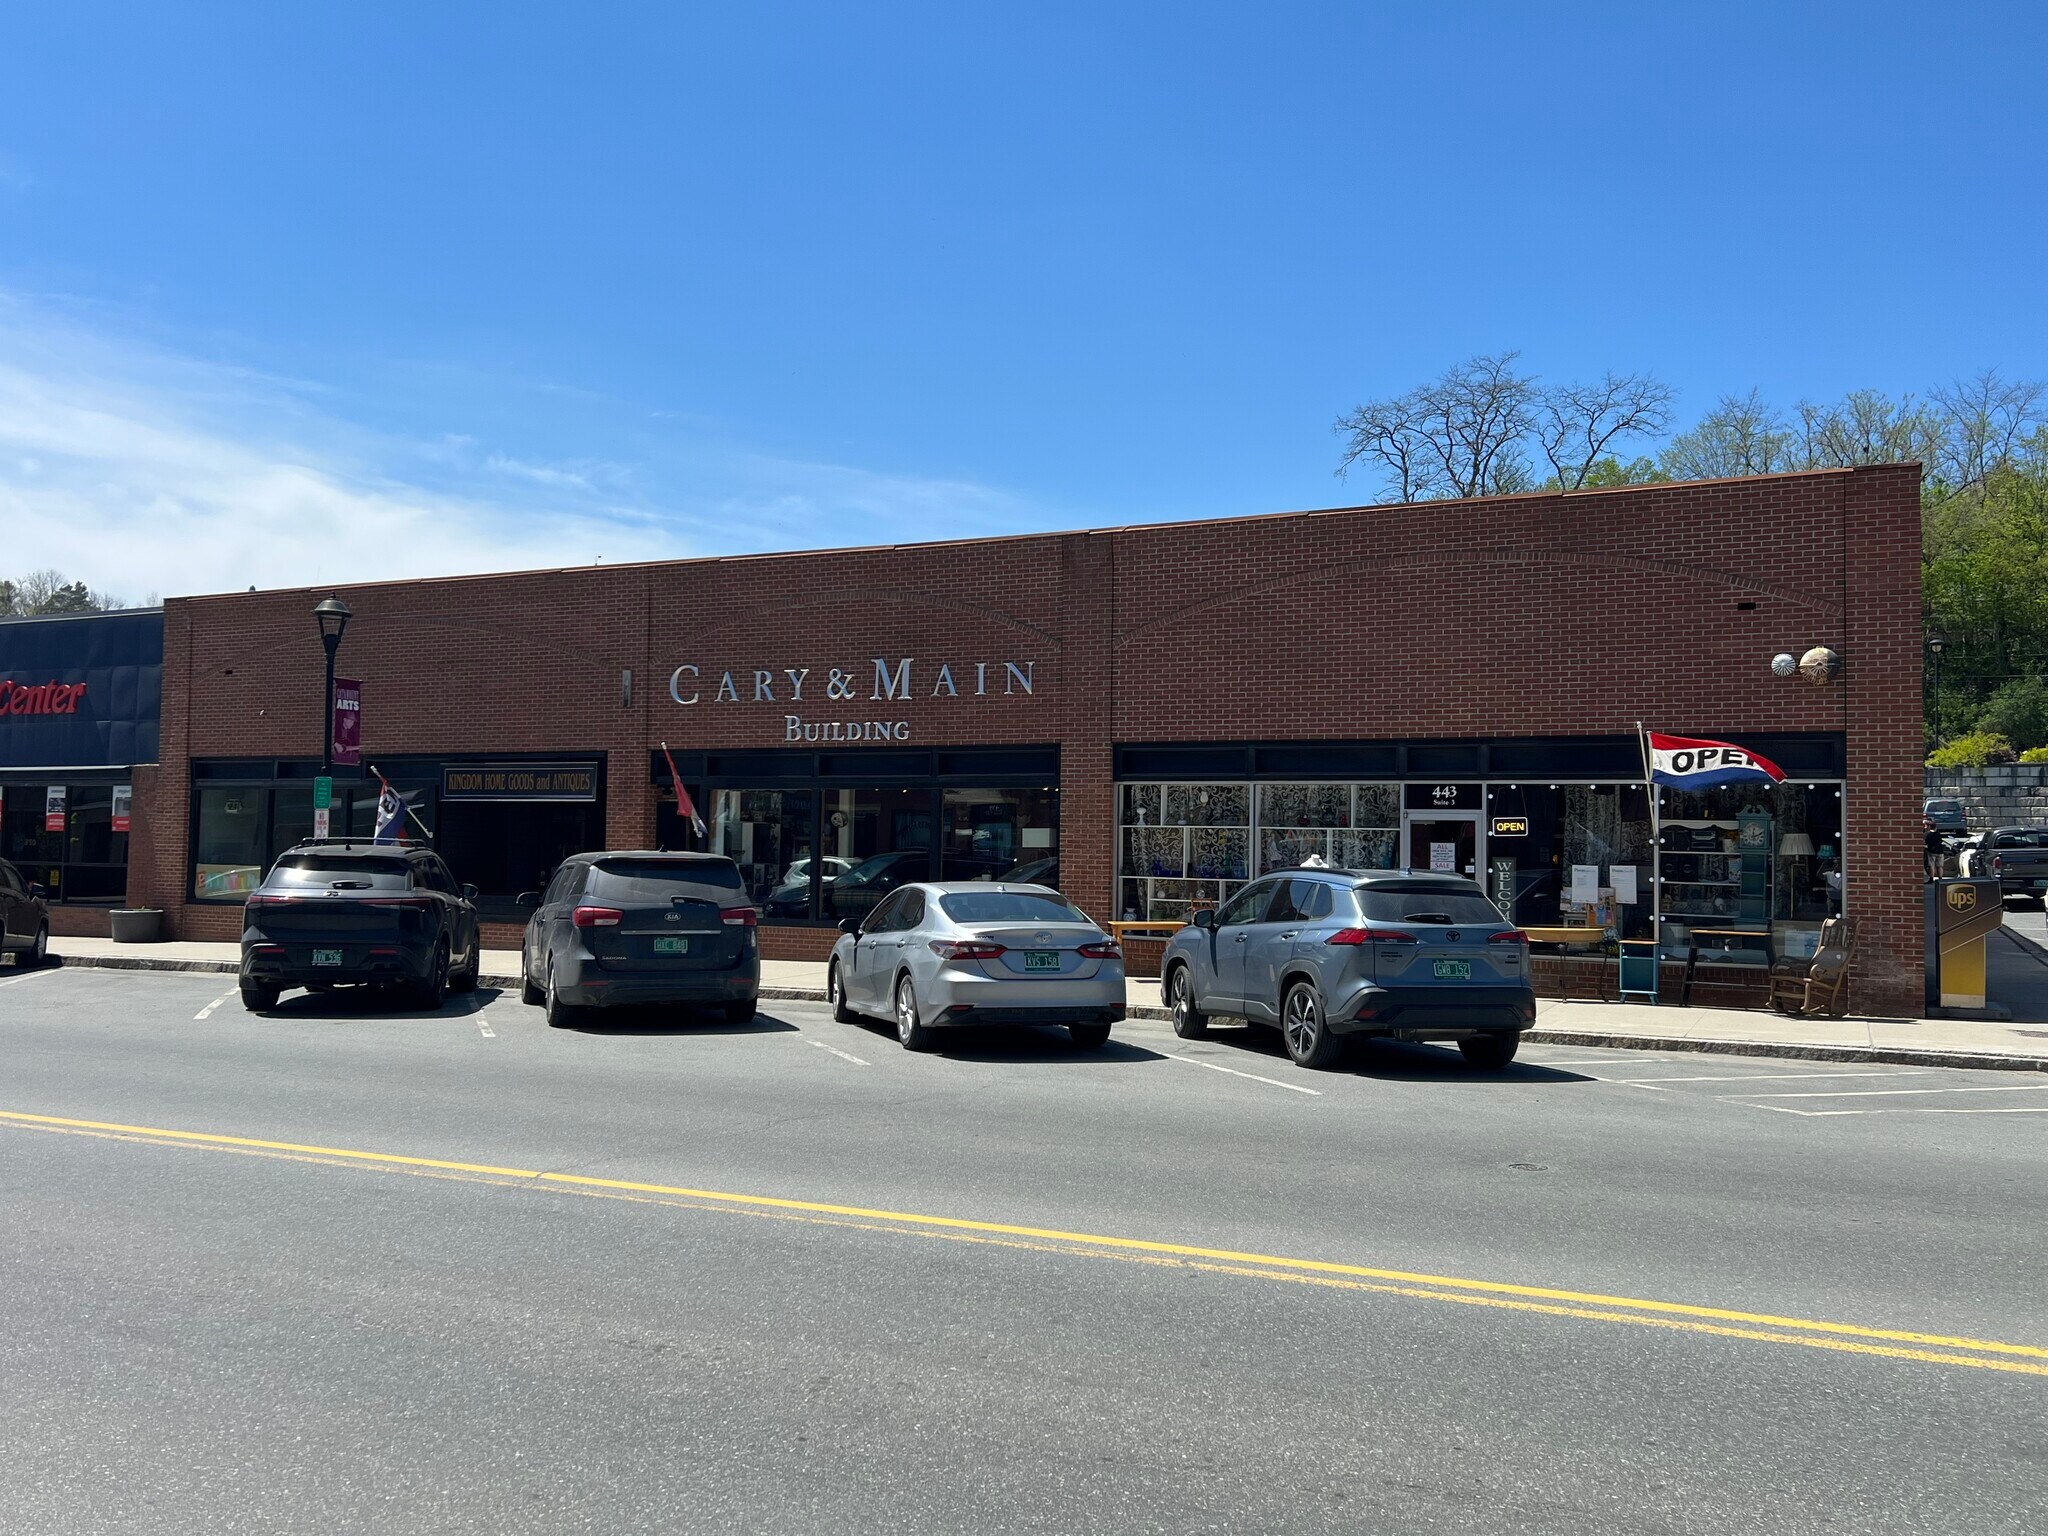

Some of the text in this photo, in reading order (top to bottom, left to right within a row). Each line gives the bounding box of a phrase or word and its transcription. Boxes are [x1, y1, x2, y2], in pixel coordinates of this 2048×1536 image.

[669, 657, 1036, 705] CARY & MAIN
[0, 679, 87, 716] Center
[336, 699, 360, 711] ARTS
[784, 715, 910, 741] BUILDING
[1671, 748, 1755, 773] OPE
[448, 773, 590, 791] KINGDOM HOME GOODS and ANTIQUES
[1432, 785, 1458, 799] 443
[1496, 822, 1525, 832] OPEN
[1496, 861, 1512, 921] WELCOM
[1949, 891, 1975, 909] ups
[1027, 956, 1058, 966] KVS 158
[1455, 965, 1469, 975] 152
